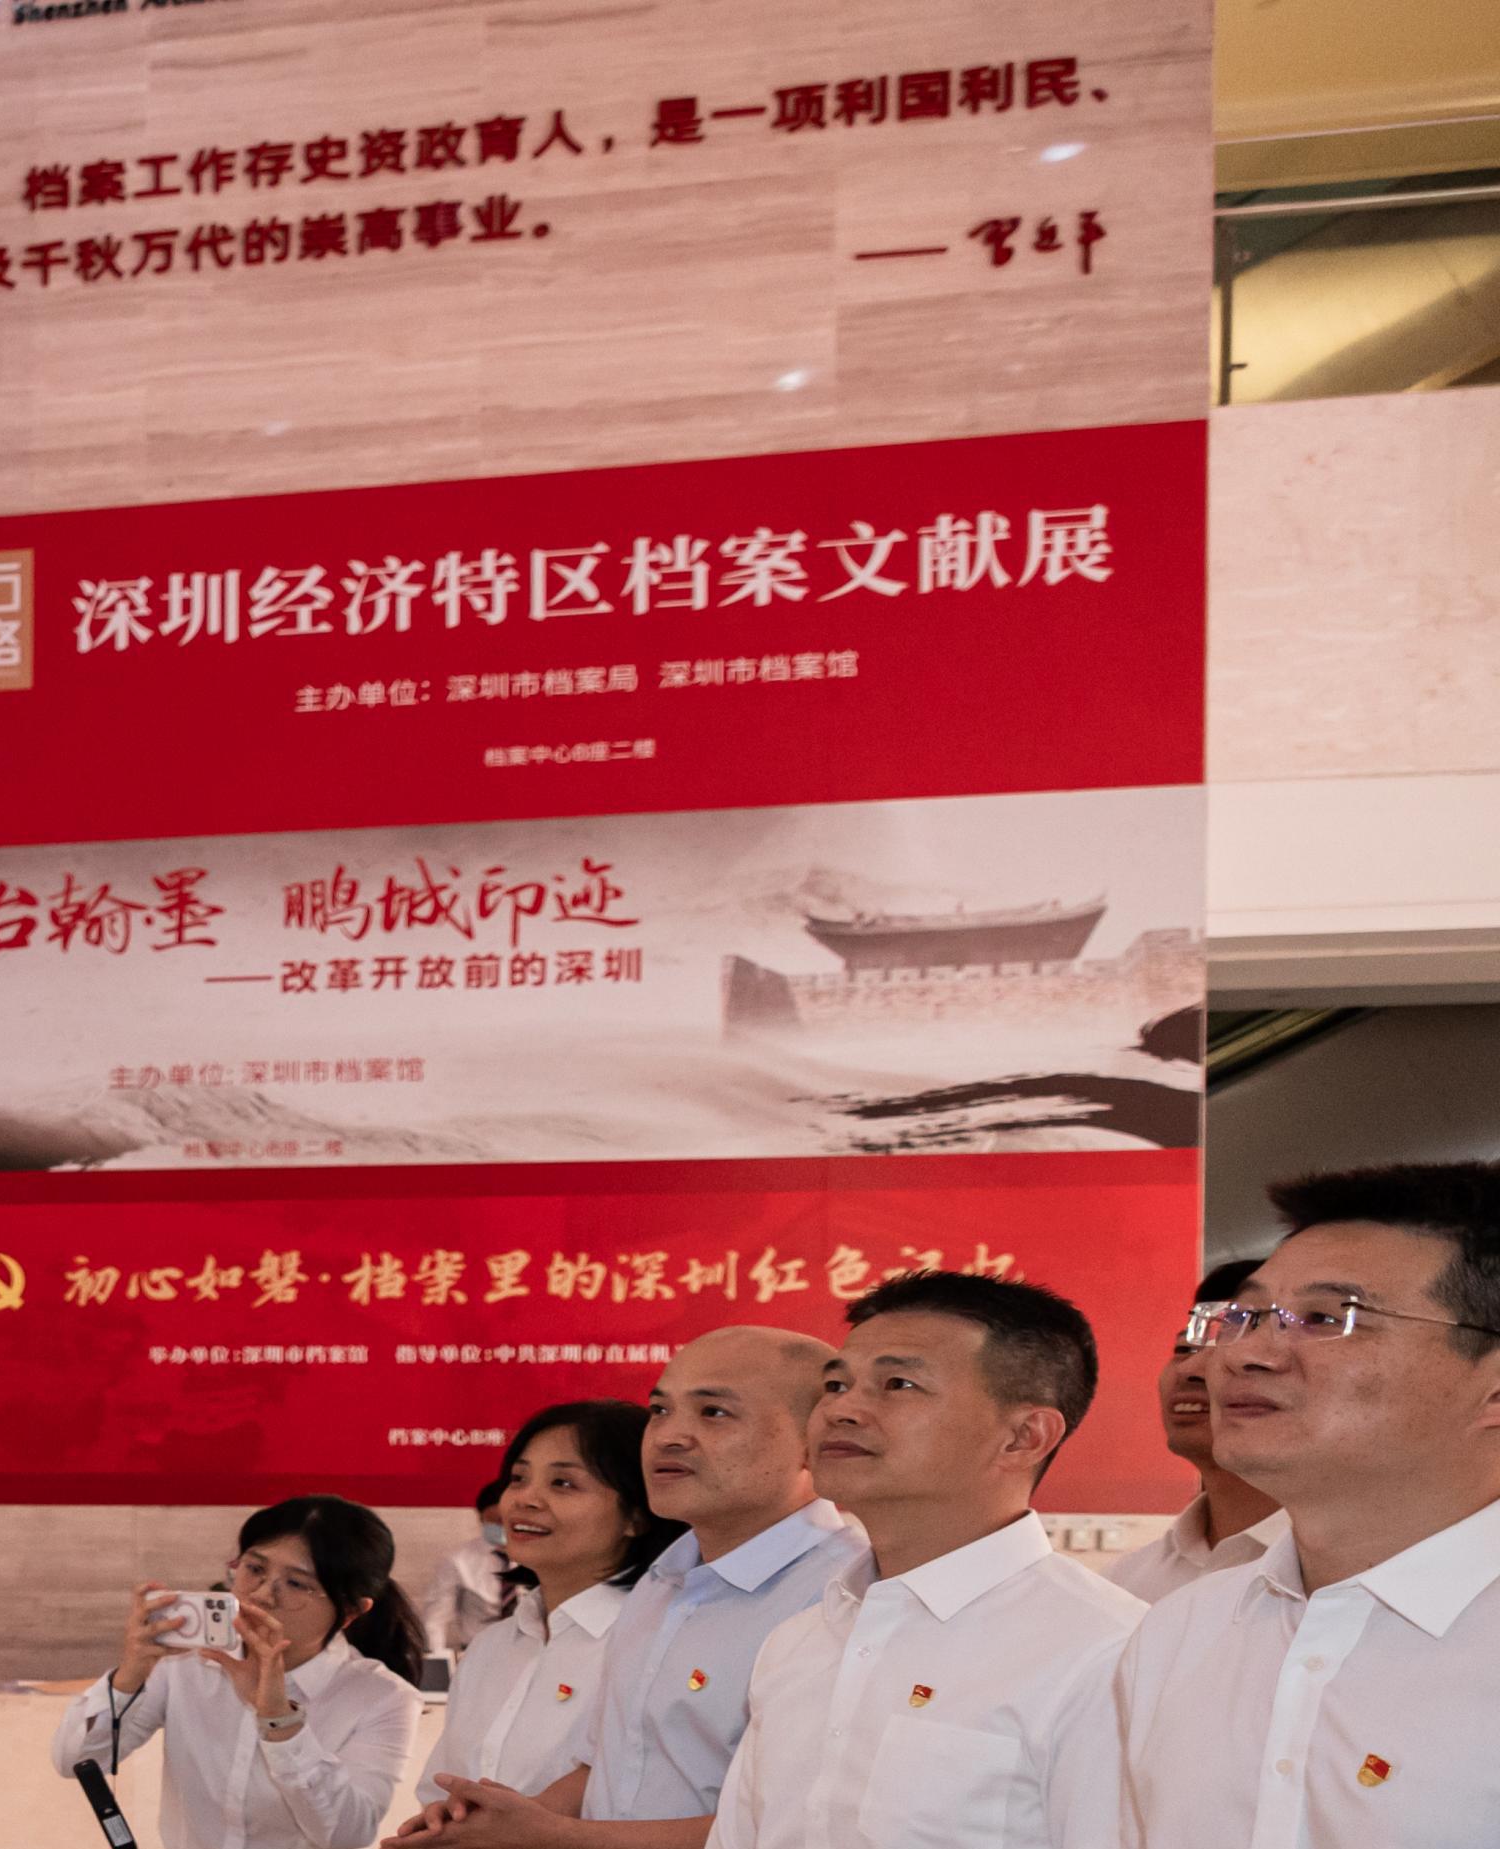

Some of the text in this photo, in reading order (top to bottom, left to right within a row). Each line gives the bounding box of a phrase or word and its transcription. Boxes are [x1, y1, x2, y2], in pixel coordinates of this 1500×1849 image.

[70, 504, 1114, 655] 深圳经济特区档案文献展
[284, 856, 643, 948] 鹏城印迹
